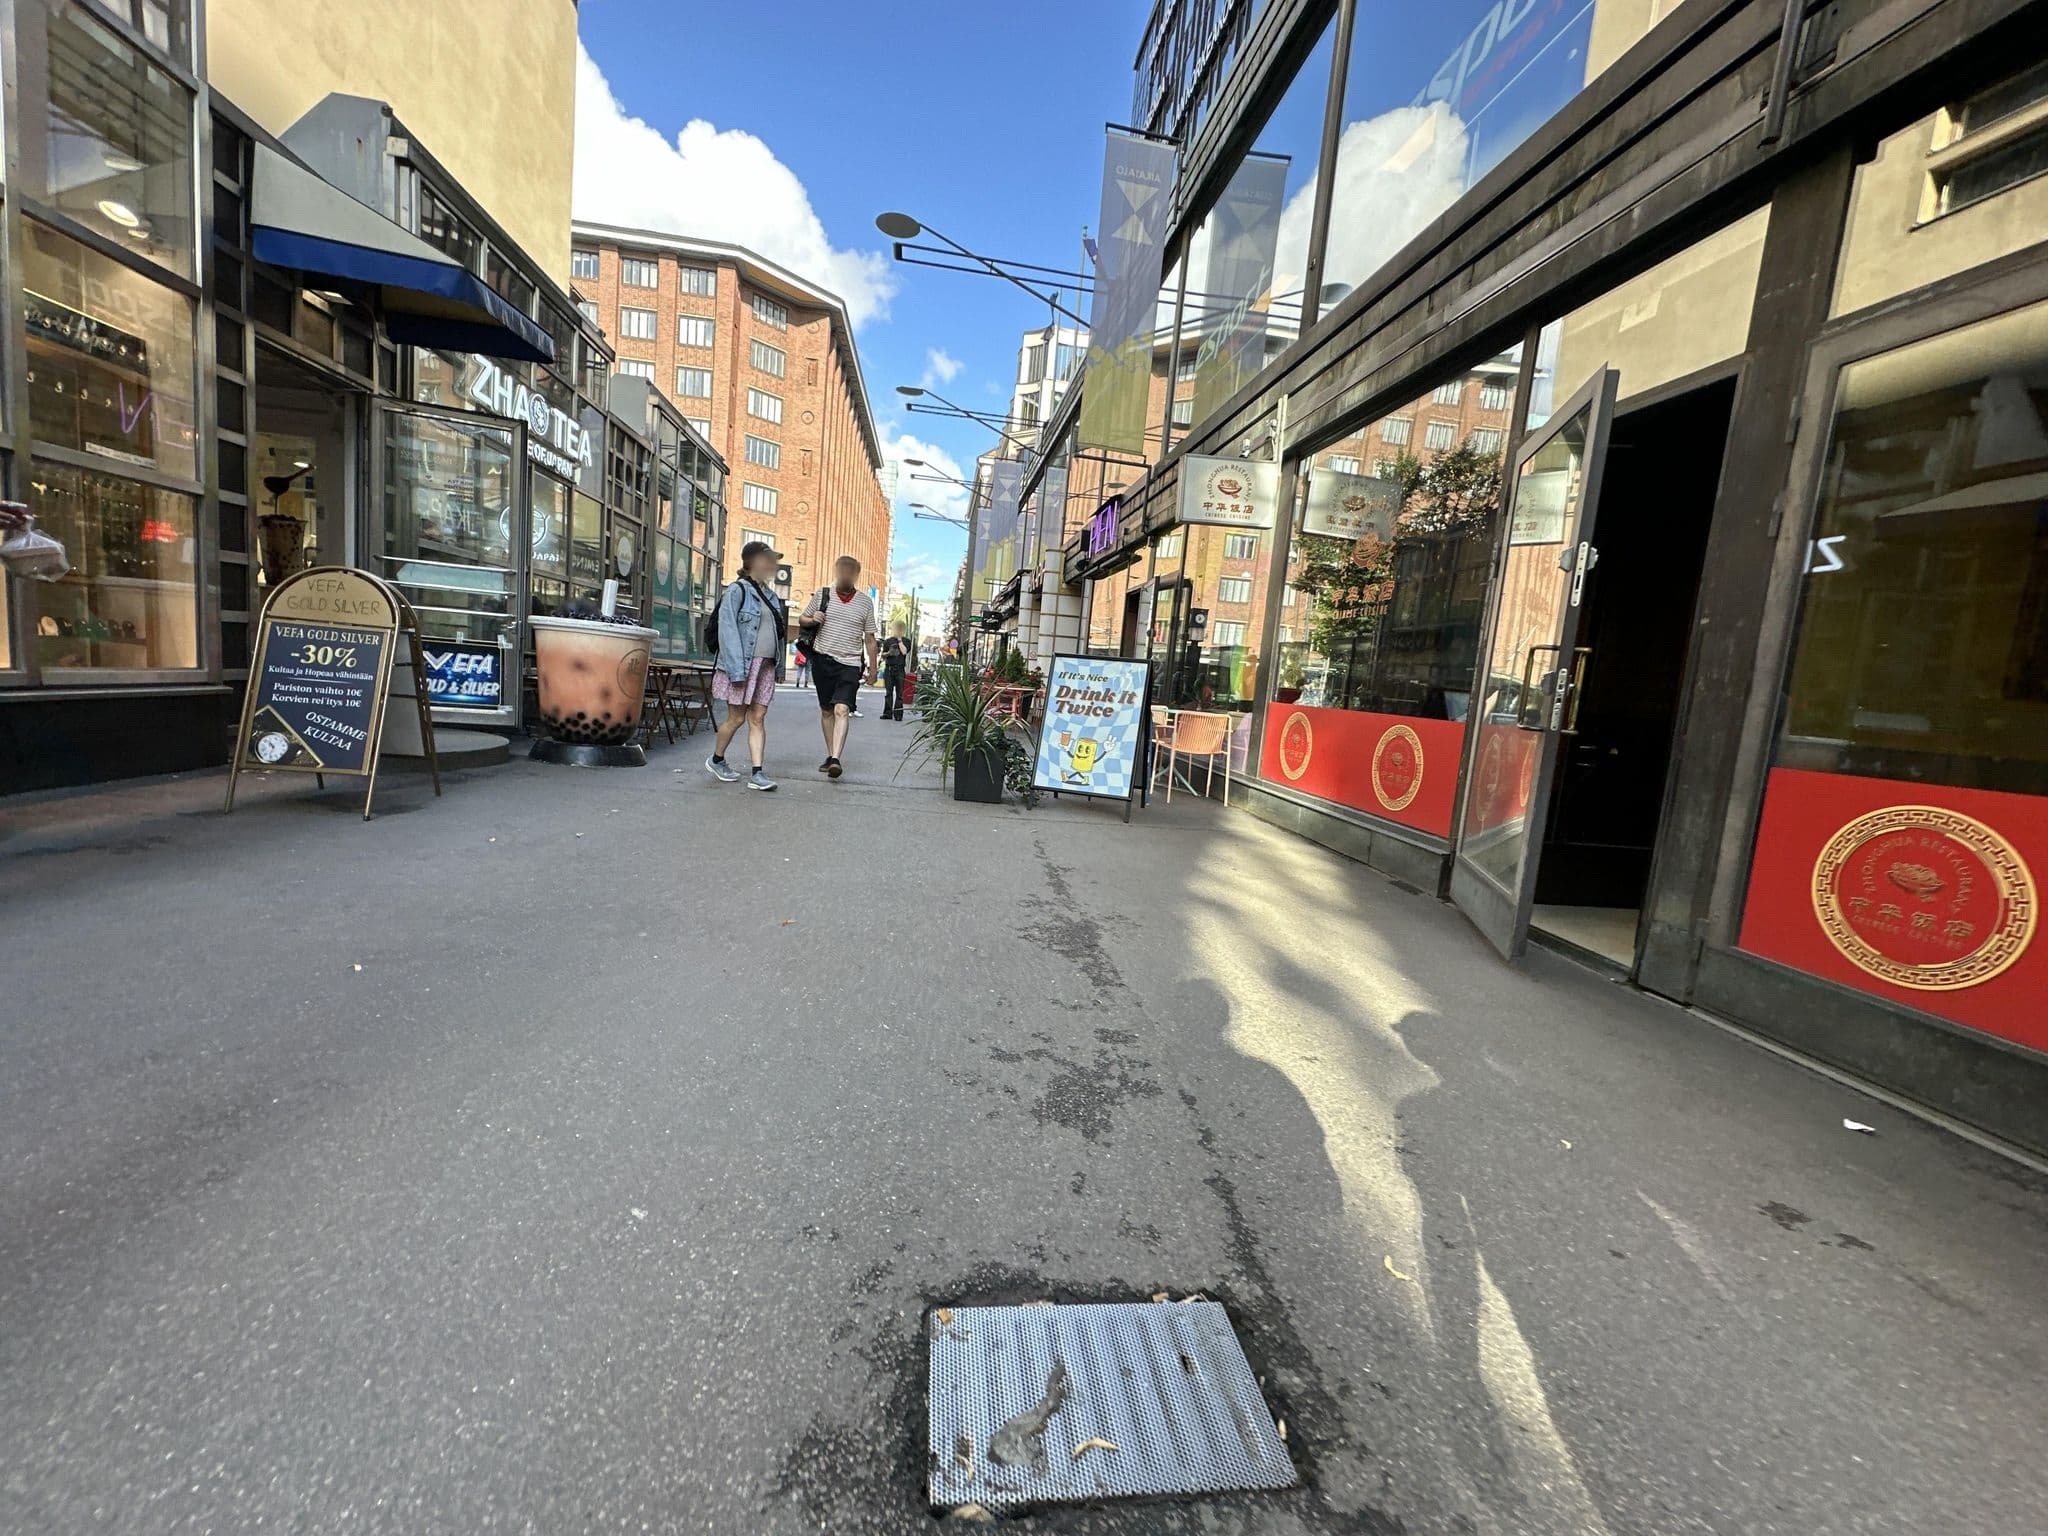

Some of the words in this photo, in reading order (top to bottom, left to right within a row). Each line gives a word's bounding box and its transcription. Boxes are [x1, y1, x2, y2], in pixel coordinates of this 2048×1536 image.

[551, 406, 593, 468] TEA
[306, 579, 345, 593] VEFA
[286, 596, 327, 611] GOLD
[276, 626, 304, 638] VEFA
[307, 629, 338, 641] GOLD
[340, 632, 380, 645] SILVER
[290, 644, 357, 668] -30%
[422, 650, 494, 674] VEFA
[268, 665, 294, 674] Kultaa
[294, 667, 303, 676] ja
[304, 668, 334, 678] Hopeaa
[335, 671, 374, 681] vähintään
[1058, 671, 1069, 679] If
[1068, 672, 1086, 680] It's
[1086, 674, 1109, 682] Nice
[273, 682, 312, 693] Pariston
[315, 686, 344, 695] vaihto
[346, 688, 363, 697] 10€
[425, 678, 448, 693] OLD
[448, 680, 460, 693] &
[460, 681, 500, 696] SILVER
[1055, 685, 1116, 703] Drink
[1118, 690, 1137, 704] It
[272, 693, 309, 704] Korvien
[346, 699, 362, 708] 10€
[1056, 700, 1114, 717] Twice
[305, 711, 367, 740] OSTAMME
[304, 726, 352, 751] KULTAA
